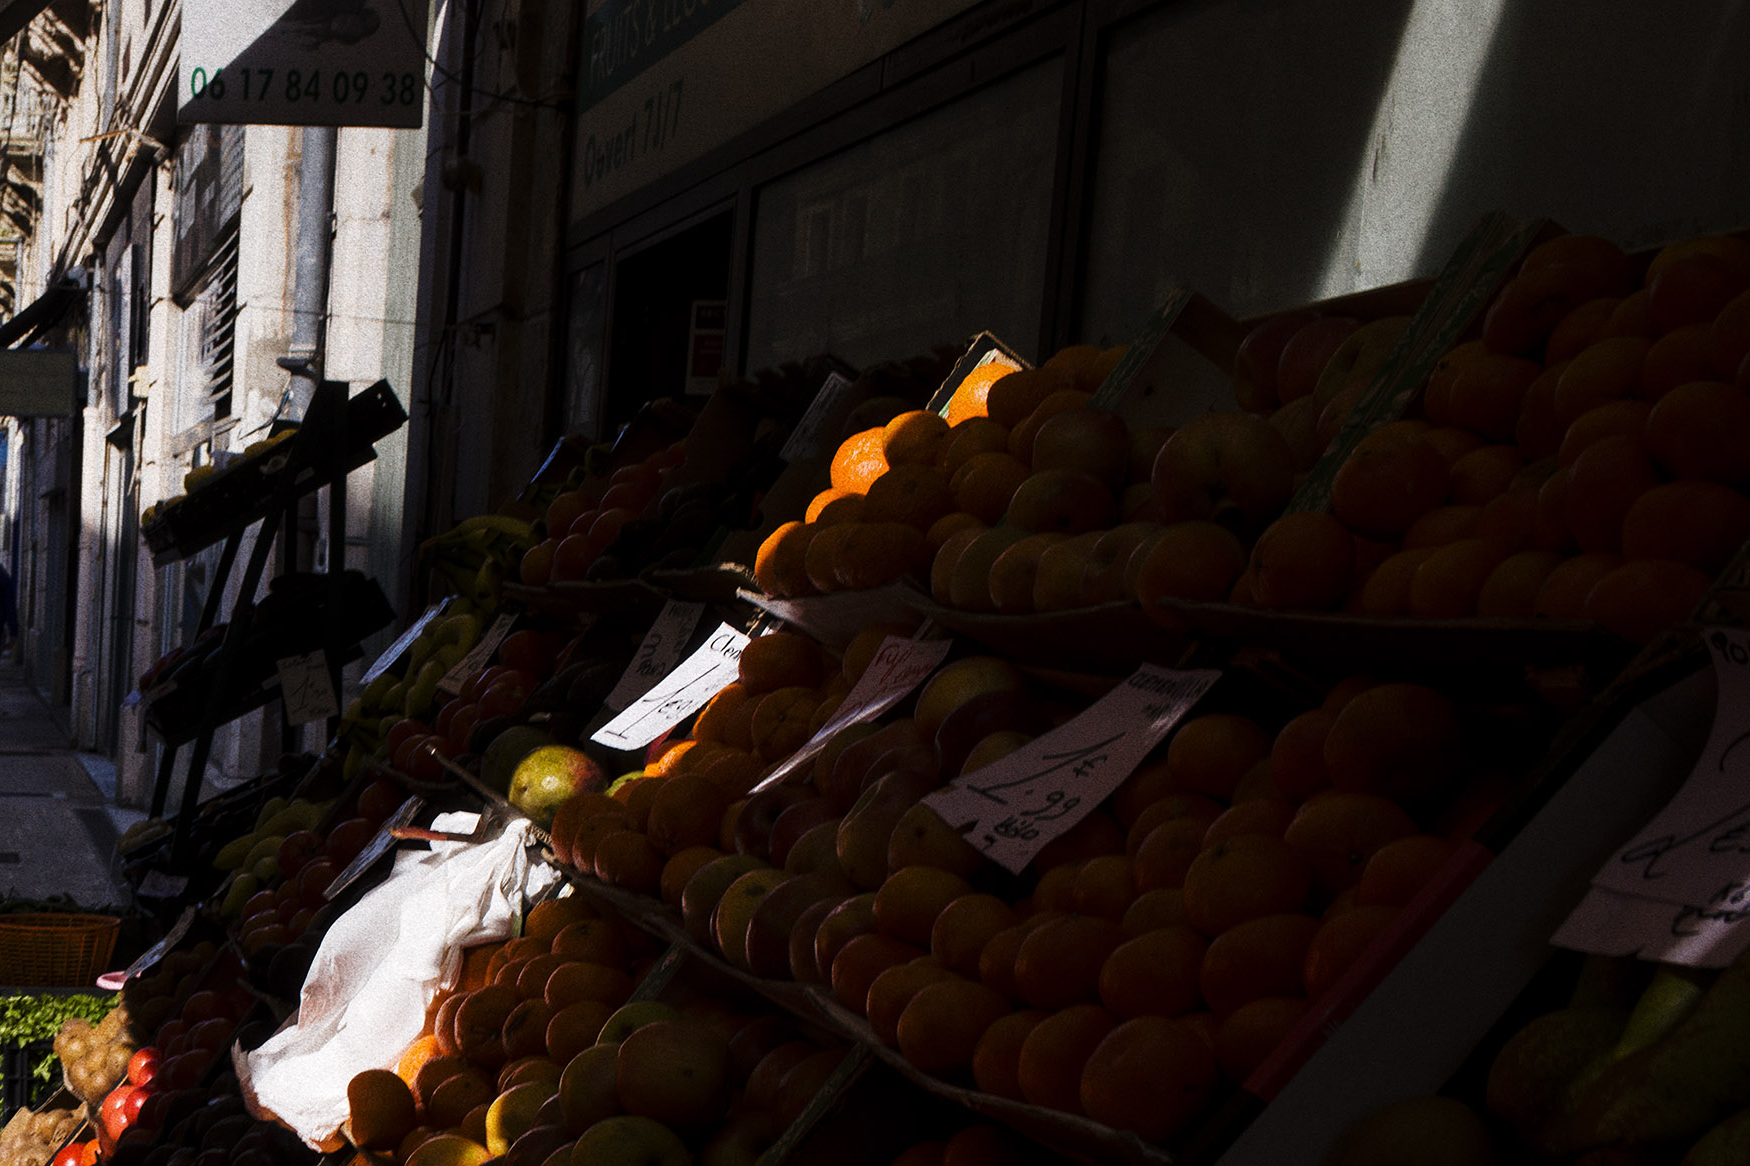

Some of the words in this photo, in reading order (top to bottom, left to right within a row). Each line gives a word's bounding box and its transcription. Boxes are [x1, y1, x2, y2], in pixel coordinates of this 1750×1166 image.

[191, 67, 225, 100] 06
[241, 68, 274, 101] 17
[286, 70, 320, 102] 84
[333, 71, 368, 104] 09
[380, 73, 415, 105] 38
[585, 111, 637, 187] Ouvert
